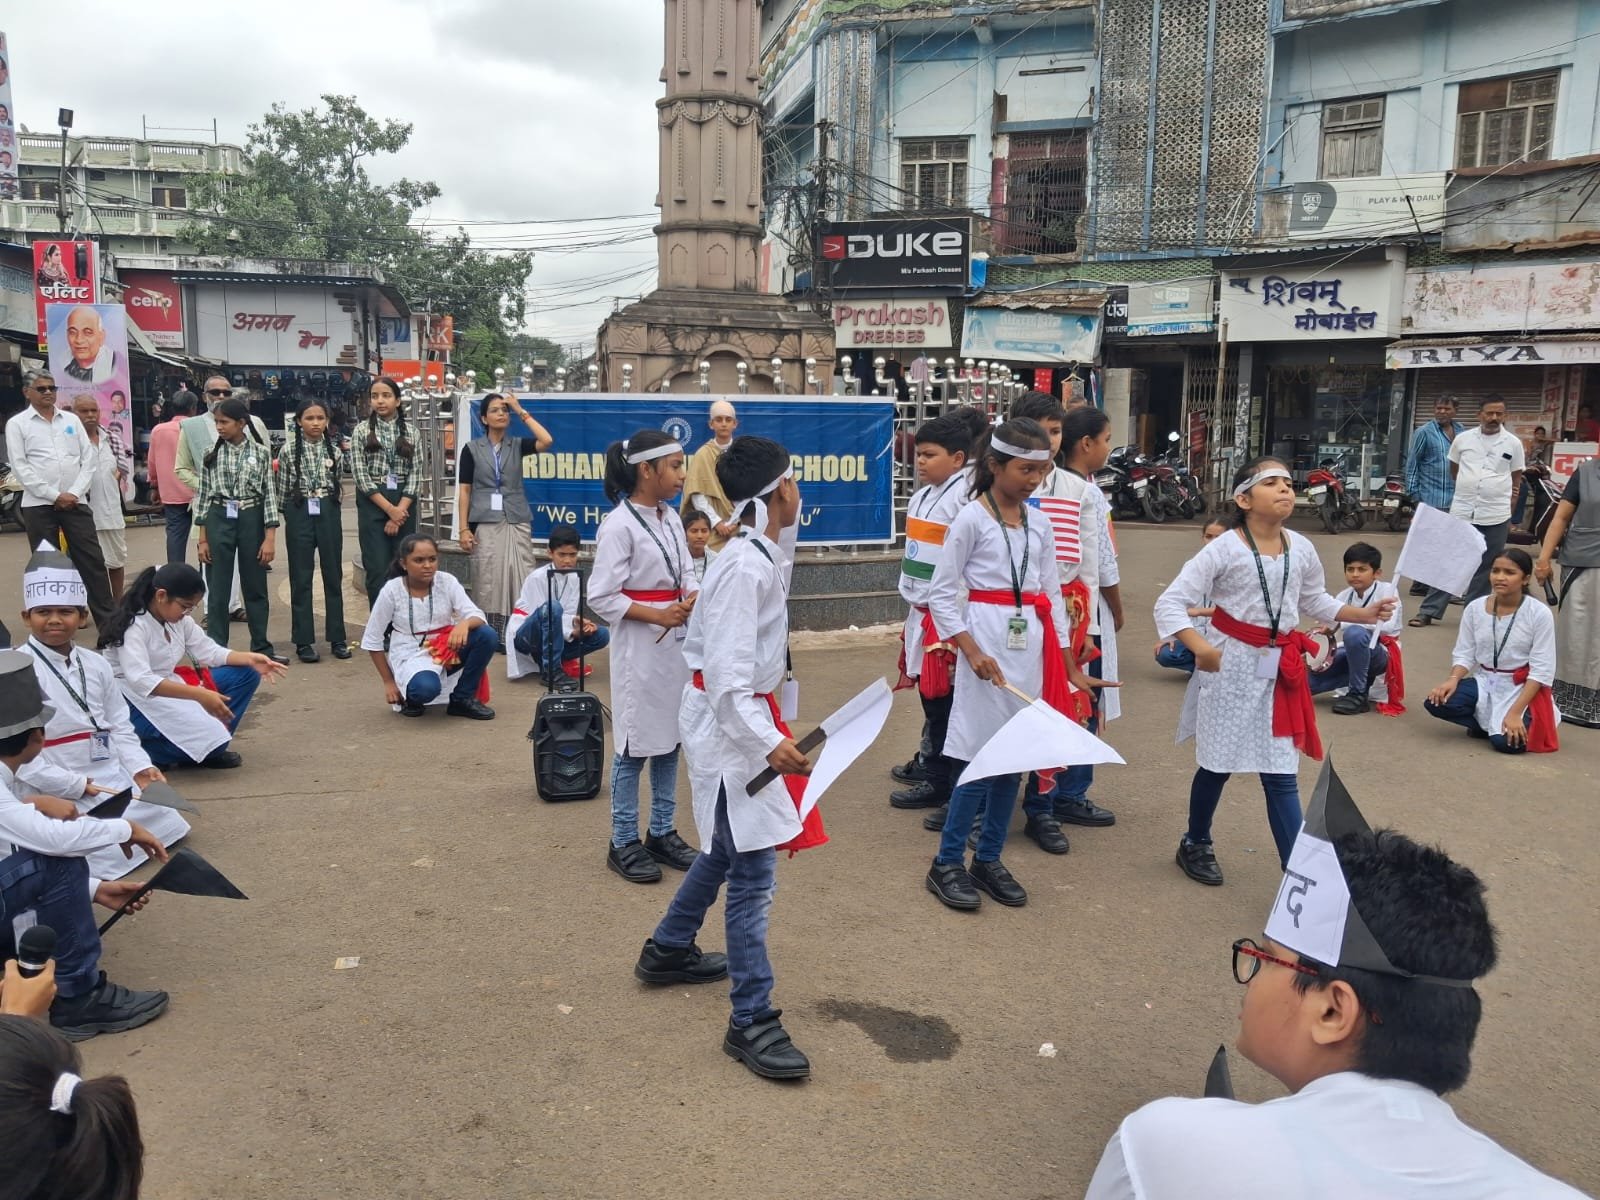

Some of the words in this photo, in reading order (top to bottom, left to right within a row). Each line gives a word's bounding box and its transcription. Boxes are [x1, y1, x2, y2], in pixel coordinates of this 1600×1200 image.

[1400, 194, 1414, 202] WN
[834, 301, 944, 327] Prakash
[853, 329, 926, 344] DRESSES
[1409, 345, 1545, 364] RIYA
[789, 454, 868, 482] CHOOL
[584, 506, 609, 525] He
